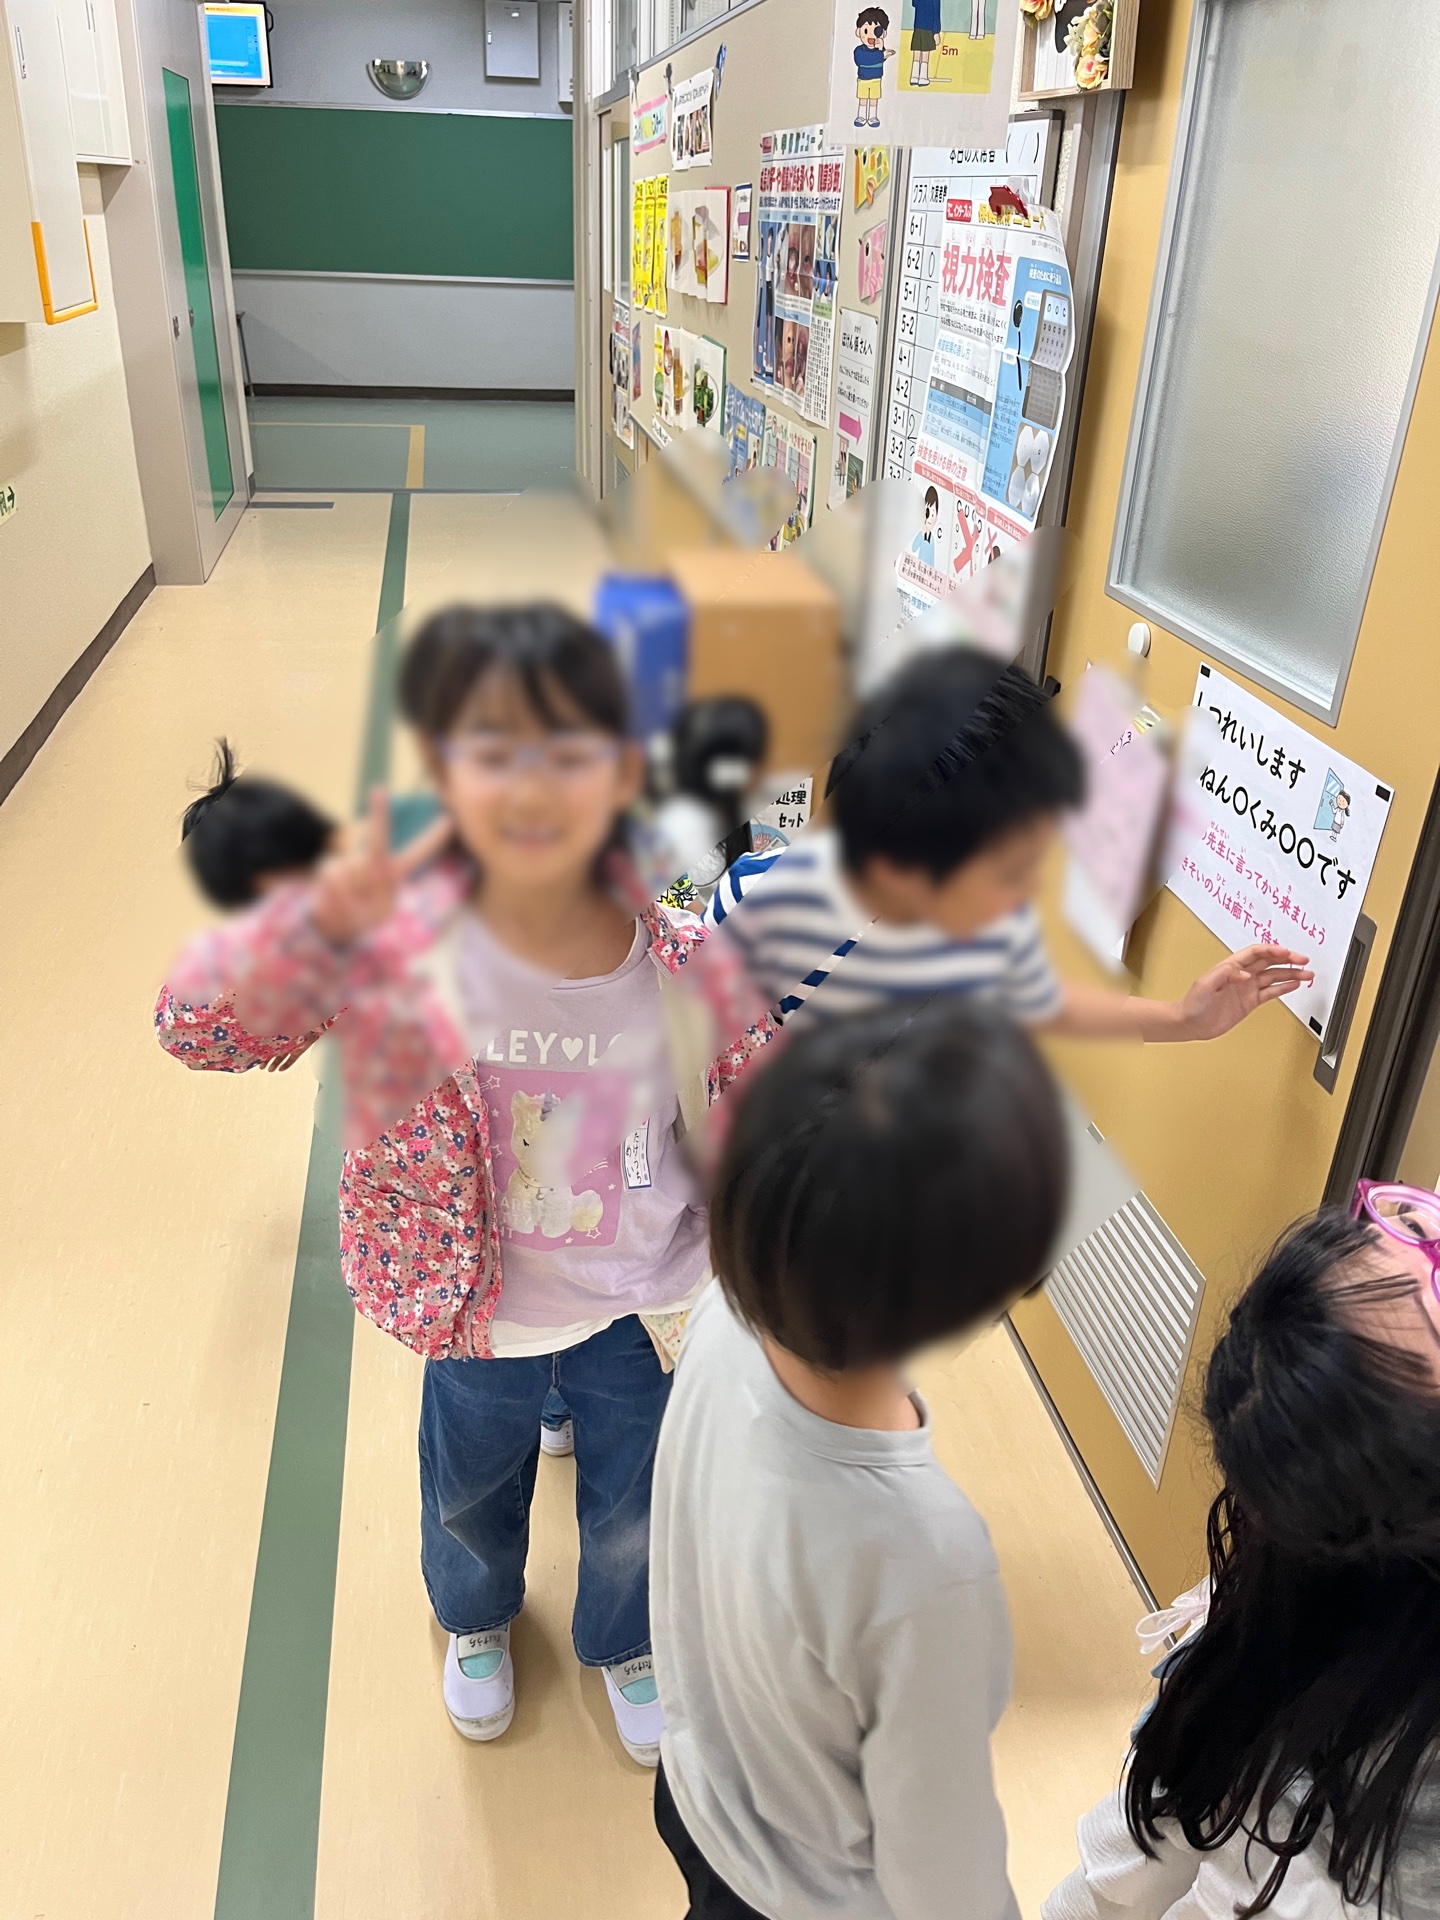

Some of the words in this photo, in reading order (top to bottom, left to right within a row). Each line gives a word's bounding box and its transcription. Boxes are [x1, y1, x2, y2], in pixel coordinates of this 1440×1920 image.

[941, 45, 959, 57] 5m
[913, 184, 928, 204] クラス
[910, 215, 923, 237] 6-1
[907, 248, 920, 270] 6-2
[942, 242, 1013, 307] 視力検査
[904, 281, 917, 304] 5-1
[901, 313, 915, 336] 5-2
[898, 347, 911, 369] 4-1
[896, 379, 909, 399] 4-2
[892, 407, 905, 428] 3-1
[890, 438, 904, 460] 3-2
[778, 812, 805, 828] セット
[1209, 820, 1231, 840] せんせい
[1216, 873, 1227, 886] ひと
[1235, 889, 1255, 910] ろうか
[632, 1130, 643, 1185] たけうち
